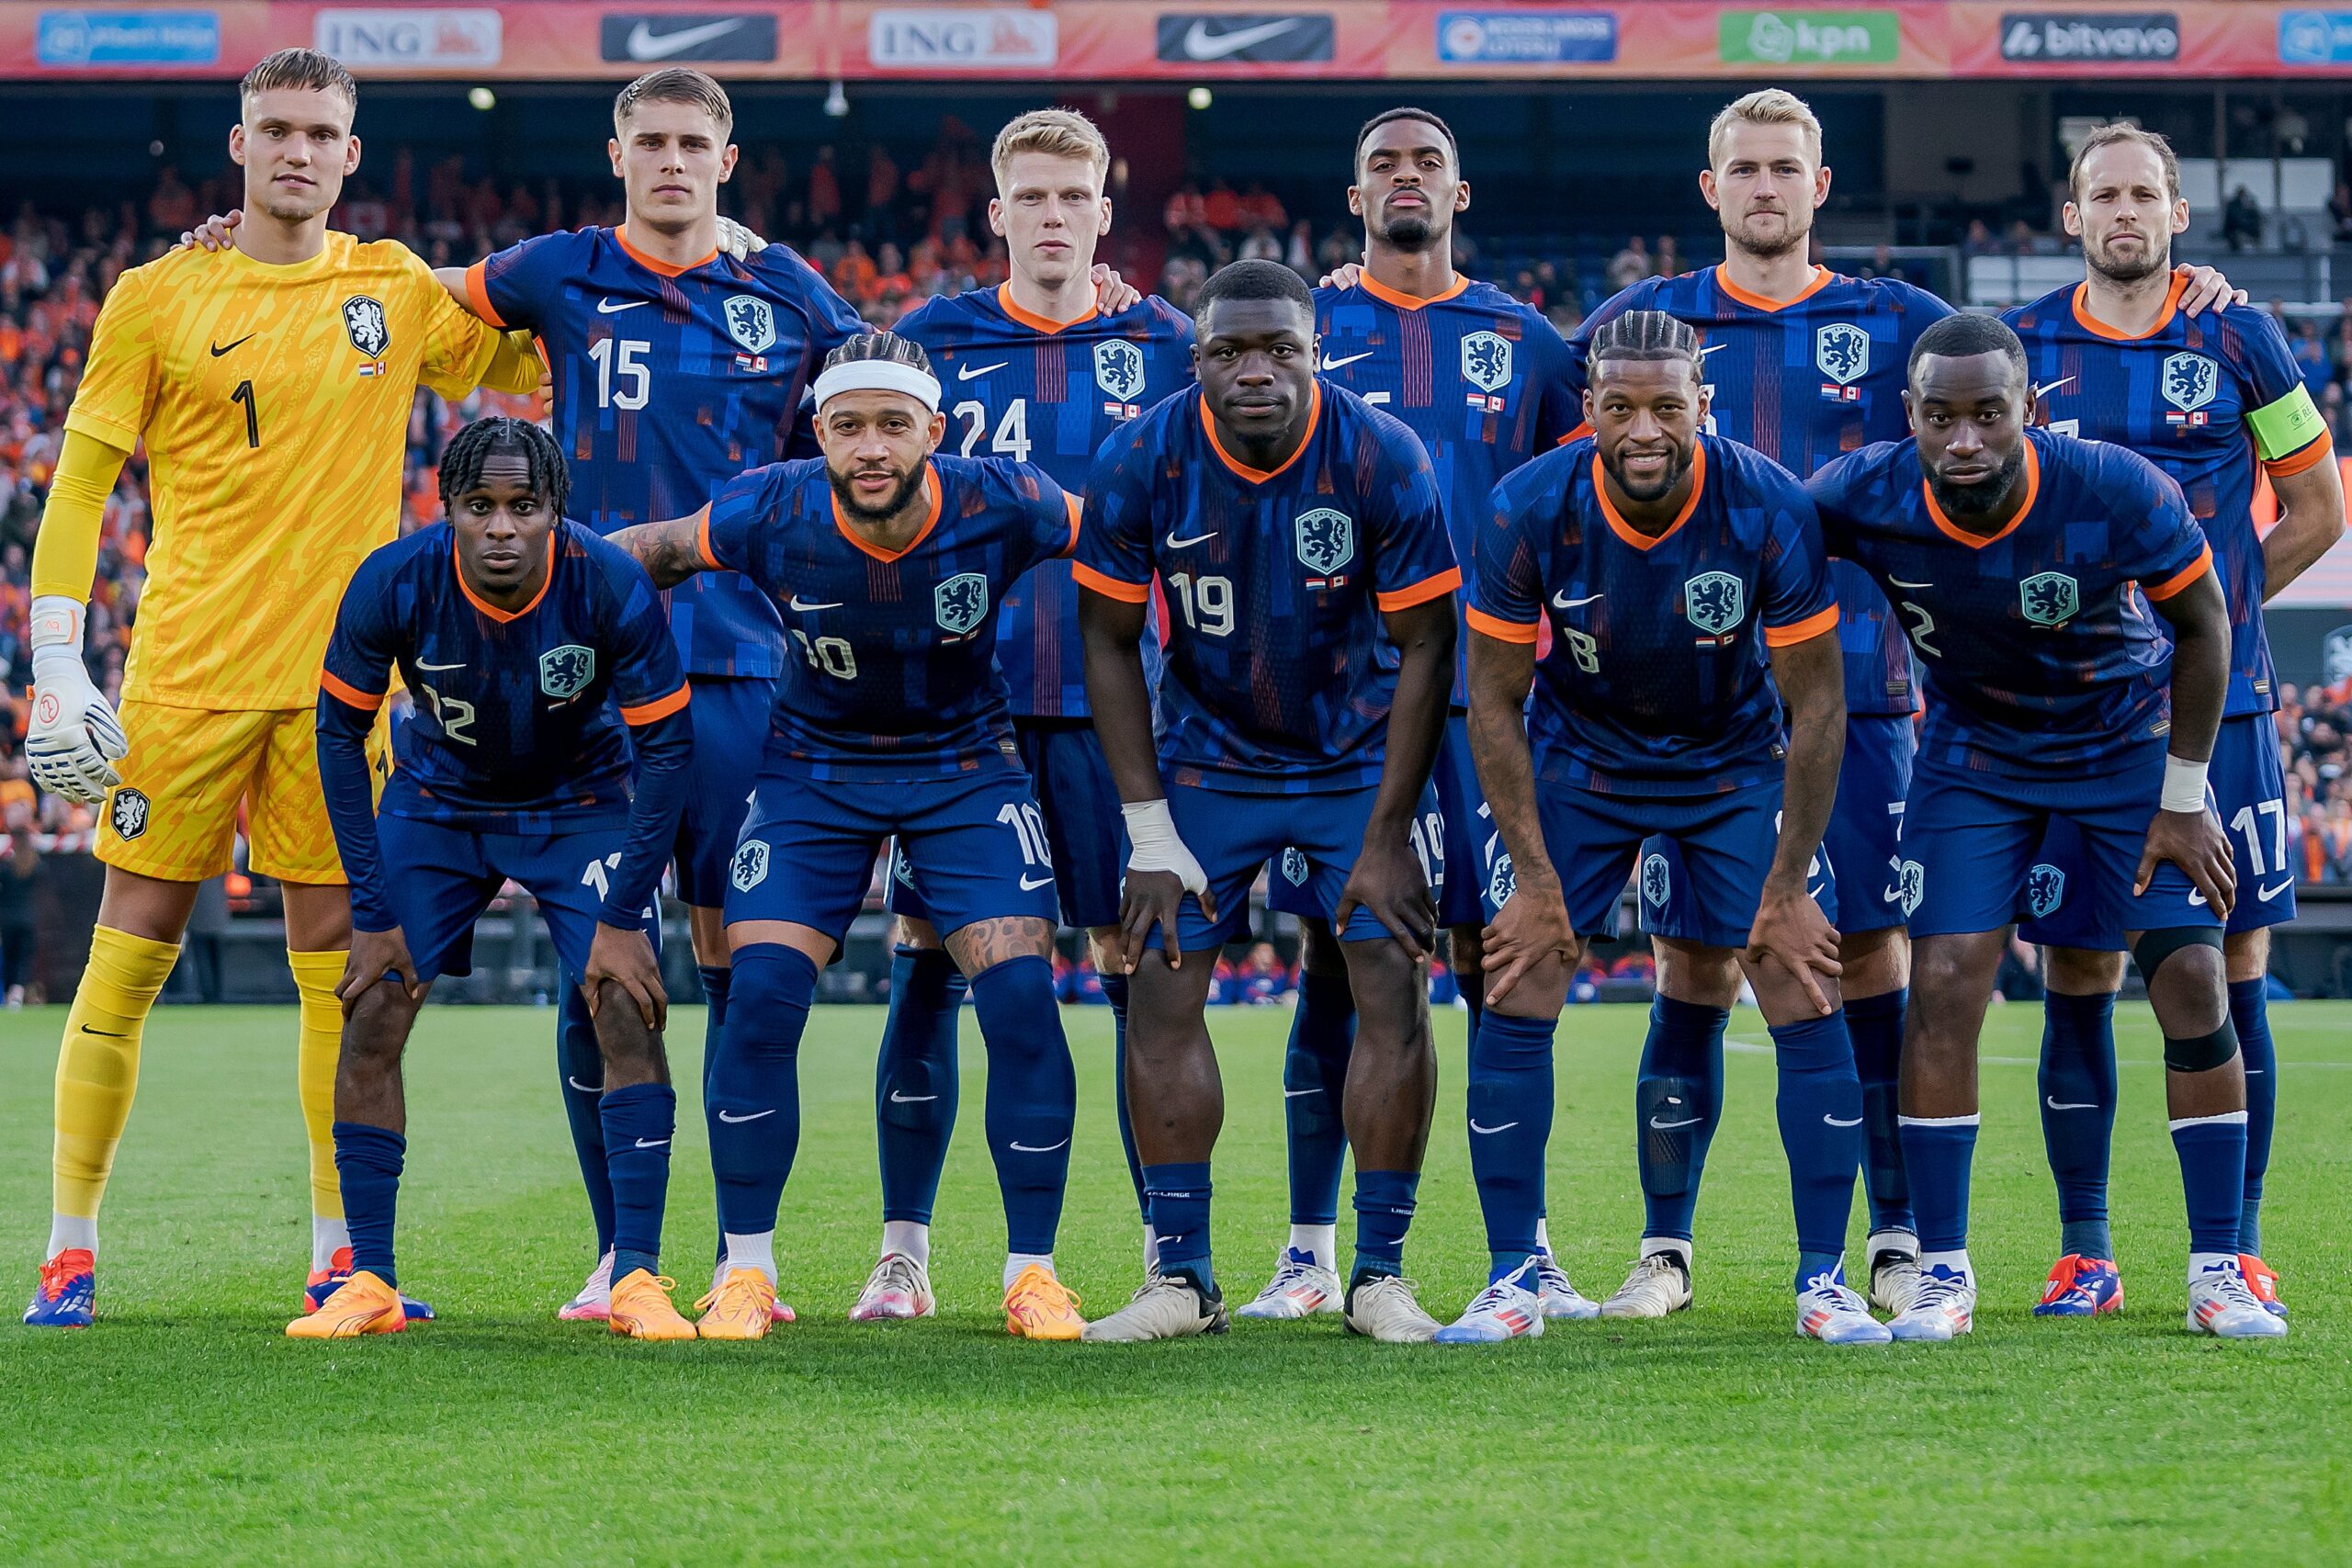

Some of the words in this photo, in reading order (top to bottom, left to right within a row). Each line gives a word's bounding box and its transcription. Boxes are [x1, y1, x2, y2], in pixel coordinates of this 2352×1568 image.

[327, 22, 423, 55] ING
[882, 22, 977, 55] ING
[1797, 20, 1871, 57] kpn
[588, 338, 650, 411] 15
[231, 379, 260, 448] 1
[952, 398, 1032, 463] 24
[1168, 571, 1235, 637] 19
[1901, 601, 1941, 658] 2
[791, 628, 857, 680] 10
[1564, 626, 1600, 673] 8
[420, 682, 477, 746] 12
[2230, 798, 2287, 875] 17
